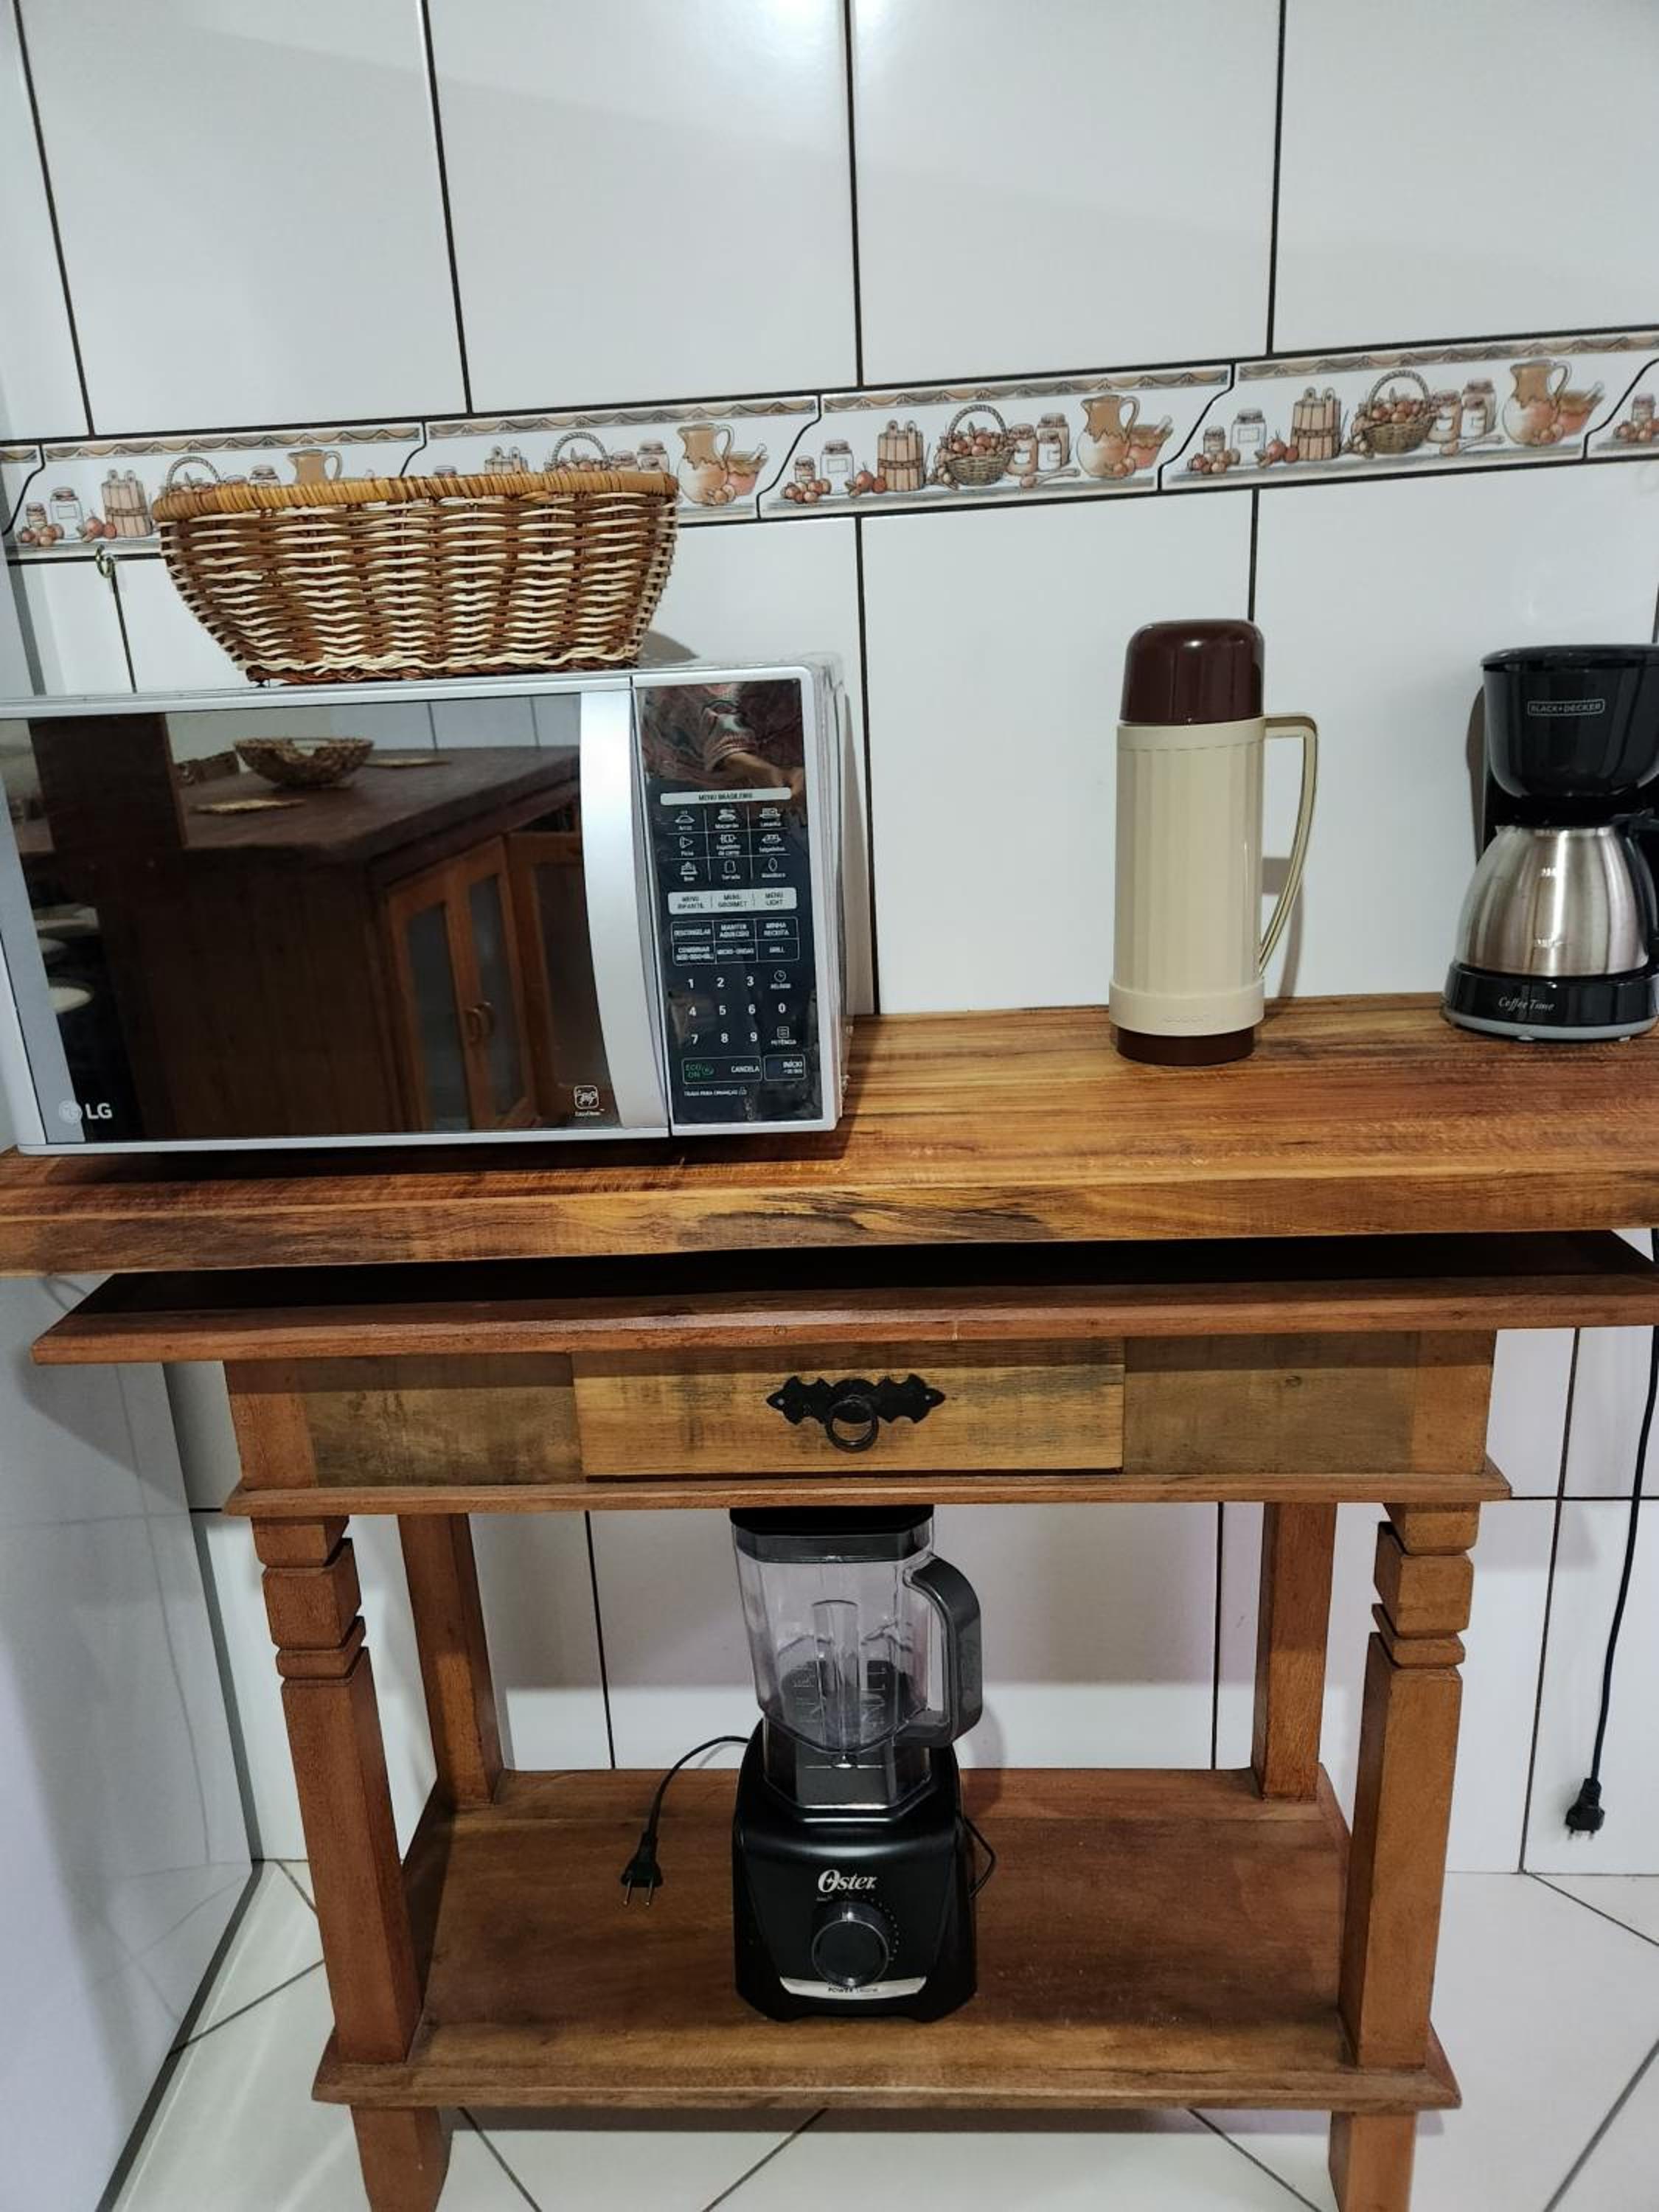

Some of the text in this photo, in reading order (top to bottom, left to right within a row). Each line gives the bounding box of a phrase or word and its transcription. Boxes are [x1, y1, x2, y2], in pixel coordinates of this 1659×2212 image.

[688, 978, 695, 989] 1
[717, 977, 725, 987] 2
[746, 975, 754, 987] 3
[748, 1004, 756, 1015] 6
[778, 1003, 786, 1013] 0
[1498, 997, 1555, 1012] Coffee Time
[689, 1006, 696, 1017] 4
[719, 1006, 726, 1015] 5
[691, 1034, 698, 1044] 7
[721, 1033, 729, 1043] 8
[750, 1032, 758, 1042] 9
[85, 1102, 113, 1120] LG
[818, 1869, 877, 1893] Oster
